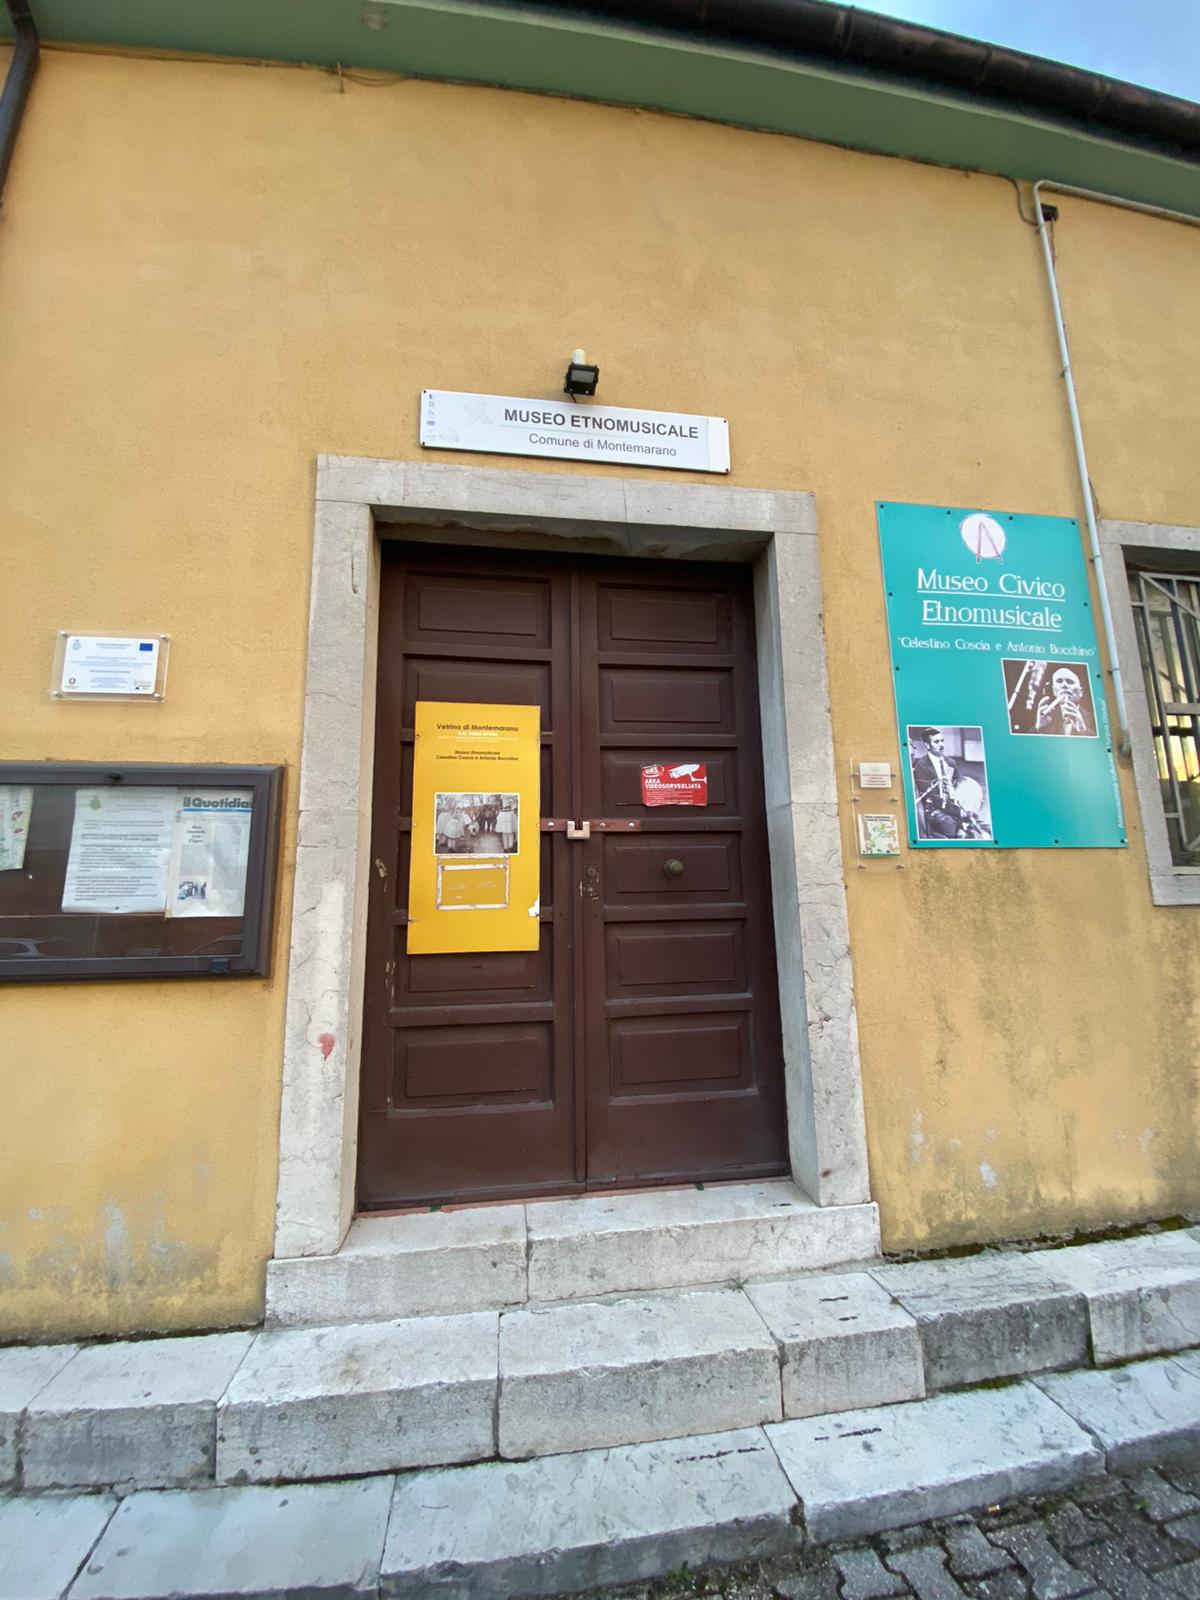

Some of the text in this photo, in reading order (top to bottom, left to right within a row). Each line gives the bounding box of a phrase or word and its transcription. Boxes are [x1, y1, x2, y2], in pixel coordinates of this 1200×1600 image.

[504, 408, 699, 439] MUSEO ETNOMUSICALE
[529, 433, 677, 457] Comune di Montemarano
[917, 567, 1066, 598] Museo Civico
[922, 600, 1063, 629] Etnomusicale
[955, 639, 991, 651] Coscia
[995, 643, 1003, 652] e
[1007, 641, 1046, 655] Antonio
[471, 724, 519, 732] Montemarano
